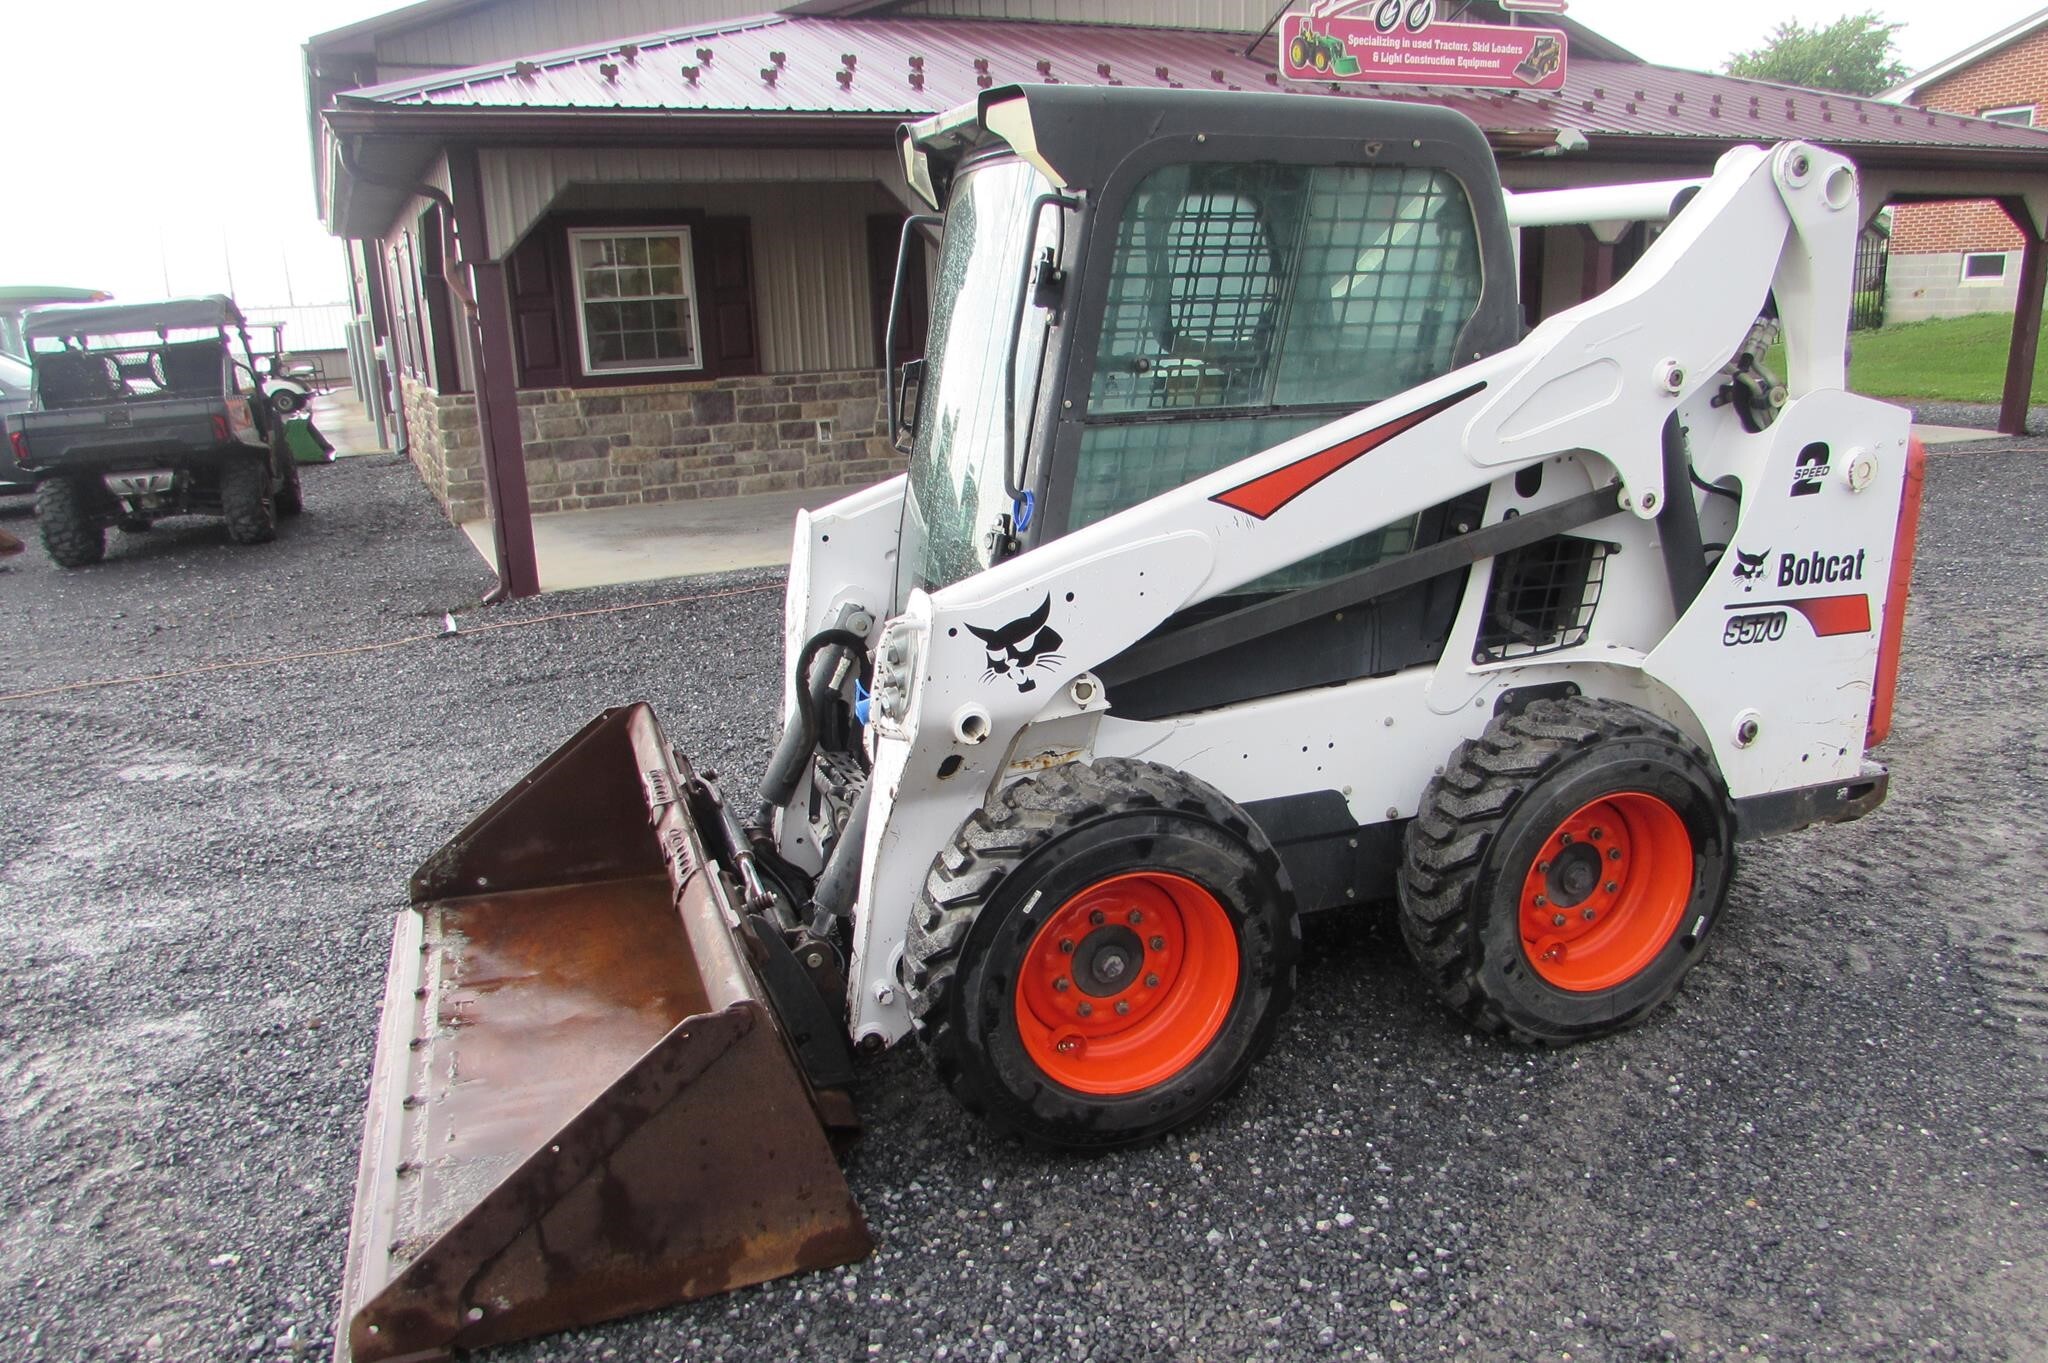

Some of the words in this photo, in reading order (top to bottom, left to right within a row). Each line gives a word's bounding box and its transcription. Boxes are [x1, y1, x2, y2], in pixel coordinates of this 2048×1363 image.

[1348, 34, 1400, 49] Specializing
[1402, 37, 1410, 48] in
[1412, 38, 1432, 49] used
[1435, 39, 1470, 52] Tractors,
[1472, 41, 1490, 53] Skid
[1491, 42, 1523, 55] Loaders
[1372, 51, 1379, 62] &
[1381, 52, 1403, 64] Light
[1404, 53, 1455, 66] Construction
[1457, 55, 1500, 69] Equipment
[1790, 441, 1830, 497] 2
[1793, 465, 1830, 480] SPEED
[1777, 548, 1865, 587] Bobcat
[1723, 611, 1788, 647] S570
